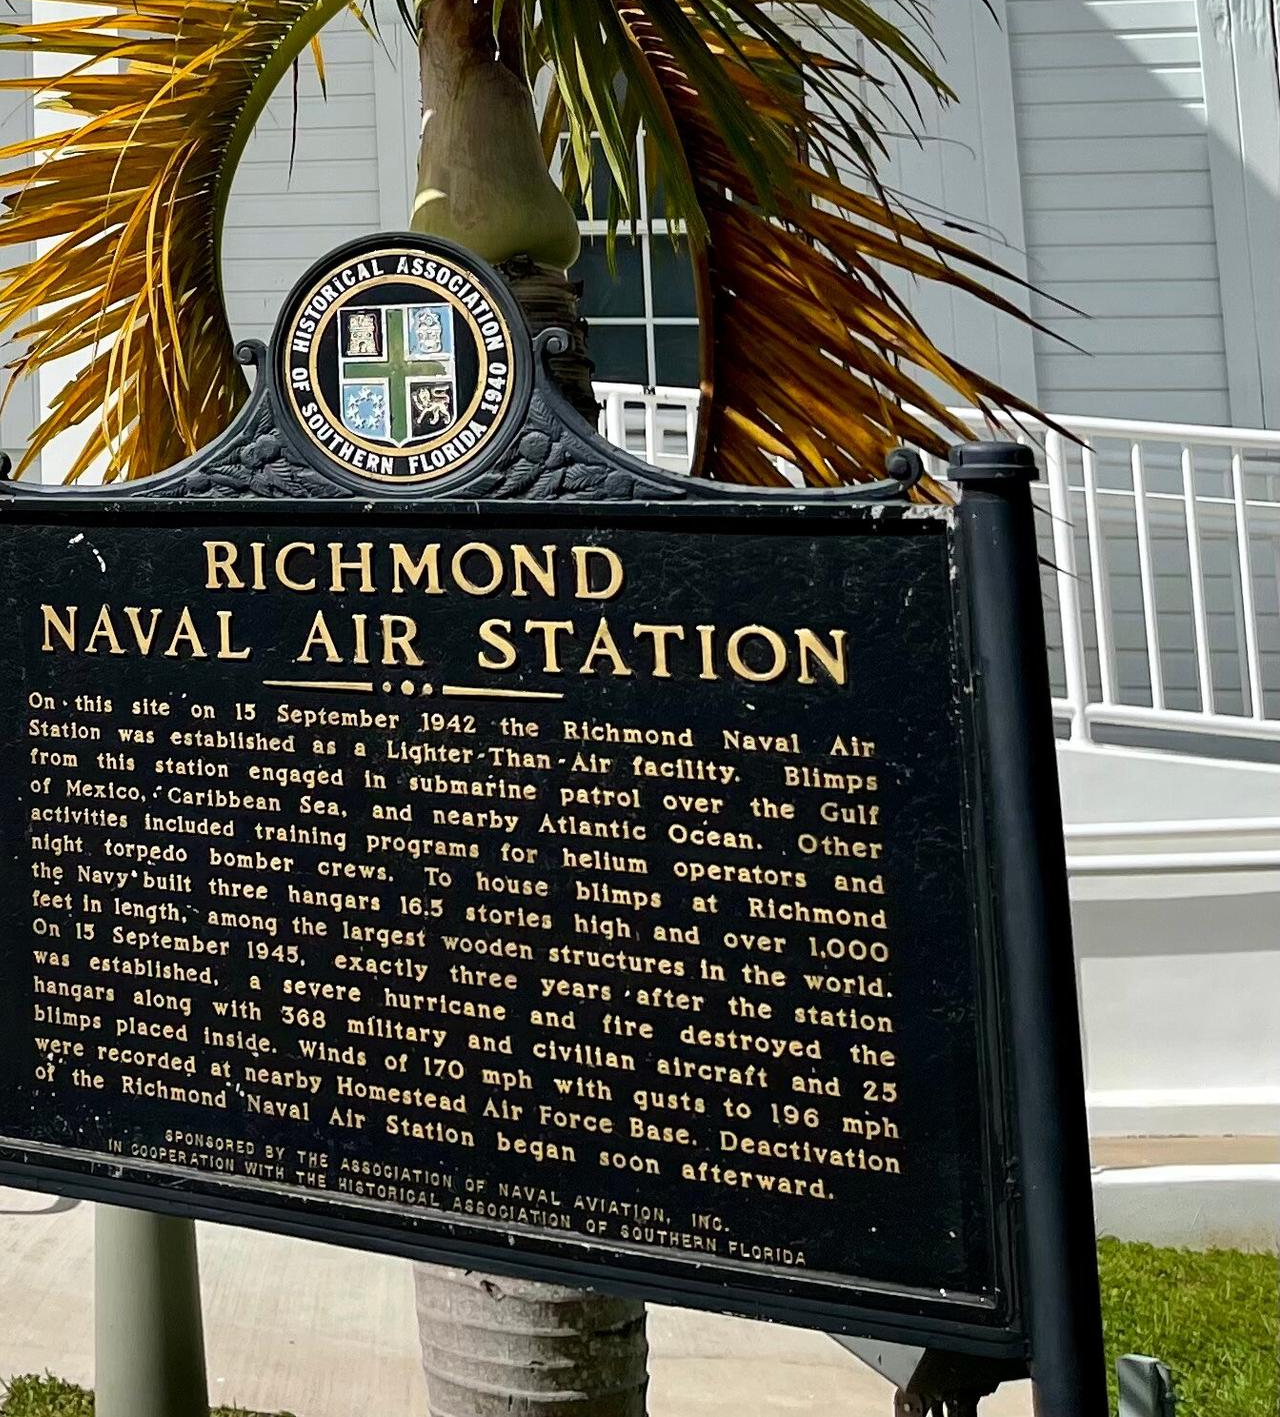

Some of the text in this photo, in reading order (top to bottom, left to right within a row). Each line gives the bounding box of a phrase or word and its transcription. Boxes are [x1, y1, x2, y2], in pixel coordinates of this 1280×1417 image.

[292, 256, 504, 353] HISTORICAL ASSOCIATION
[292, 362, 507, 474] OF SOUTHERN FLORIDA 1940
[202, 540, 624, 600] RICHMOND
[40, 603, 848, 685] NAVAL AIR STATION
[27, 690, 876, 758] On this site on 15 September 1942 the Richmond Naval Air
[28, 718, 878, 795] Station was established as Blimps
[29, 746, 880, 826] from this station engaged in submarine patrol over the Gulf
[29, 776, 883, 860] of Caribbean and nearby Atlantic Other
[30, 805, 885, 896] activities included training programs for helium operators and
[30, 832, 888, 930] night torpedo bomber To house blimps at Richmond
[30, 860, 788, 954] the Navy built three hangars stories and over
[31, 888, 894, 999] feet in among the largest wooden structures in the world.
[31, 916, 894, 1034] On 15 September exactly three years after the station
[31, 949, 896, 1068] was severe hurricane and fire destroyed the
[32, 974, 898, 1104] hangars along with 368 military and civilian aircraft and 25
[33, 1003, 900, 1141] blimps placed inside. Winds of 170 mph with gusts to 196 mph
[70, 1067, 835, 1201] the Richmond Naval Air Station began soon afterward.
[96, 1044, 901, 1175] recorded at nearby Homestead Air Force Base. Deactivation
[108, 1139, 806, 1265] IN COOPERATION WITH THE HISTORICAL ASSOCIATION OF SOUTHERN FLORIDA
[165, 1129, 730, 1232] SPONSORED BY THE ASSOCIATION OF NAVAL AVIATION, INC.
